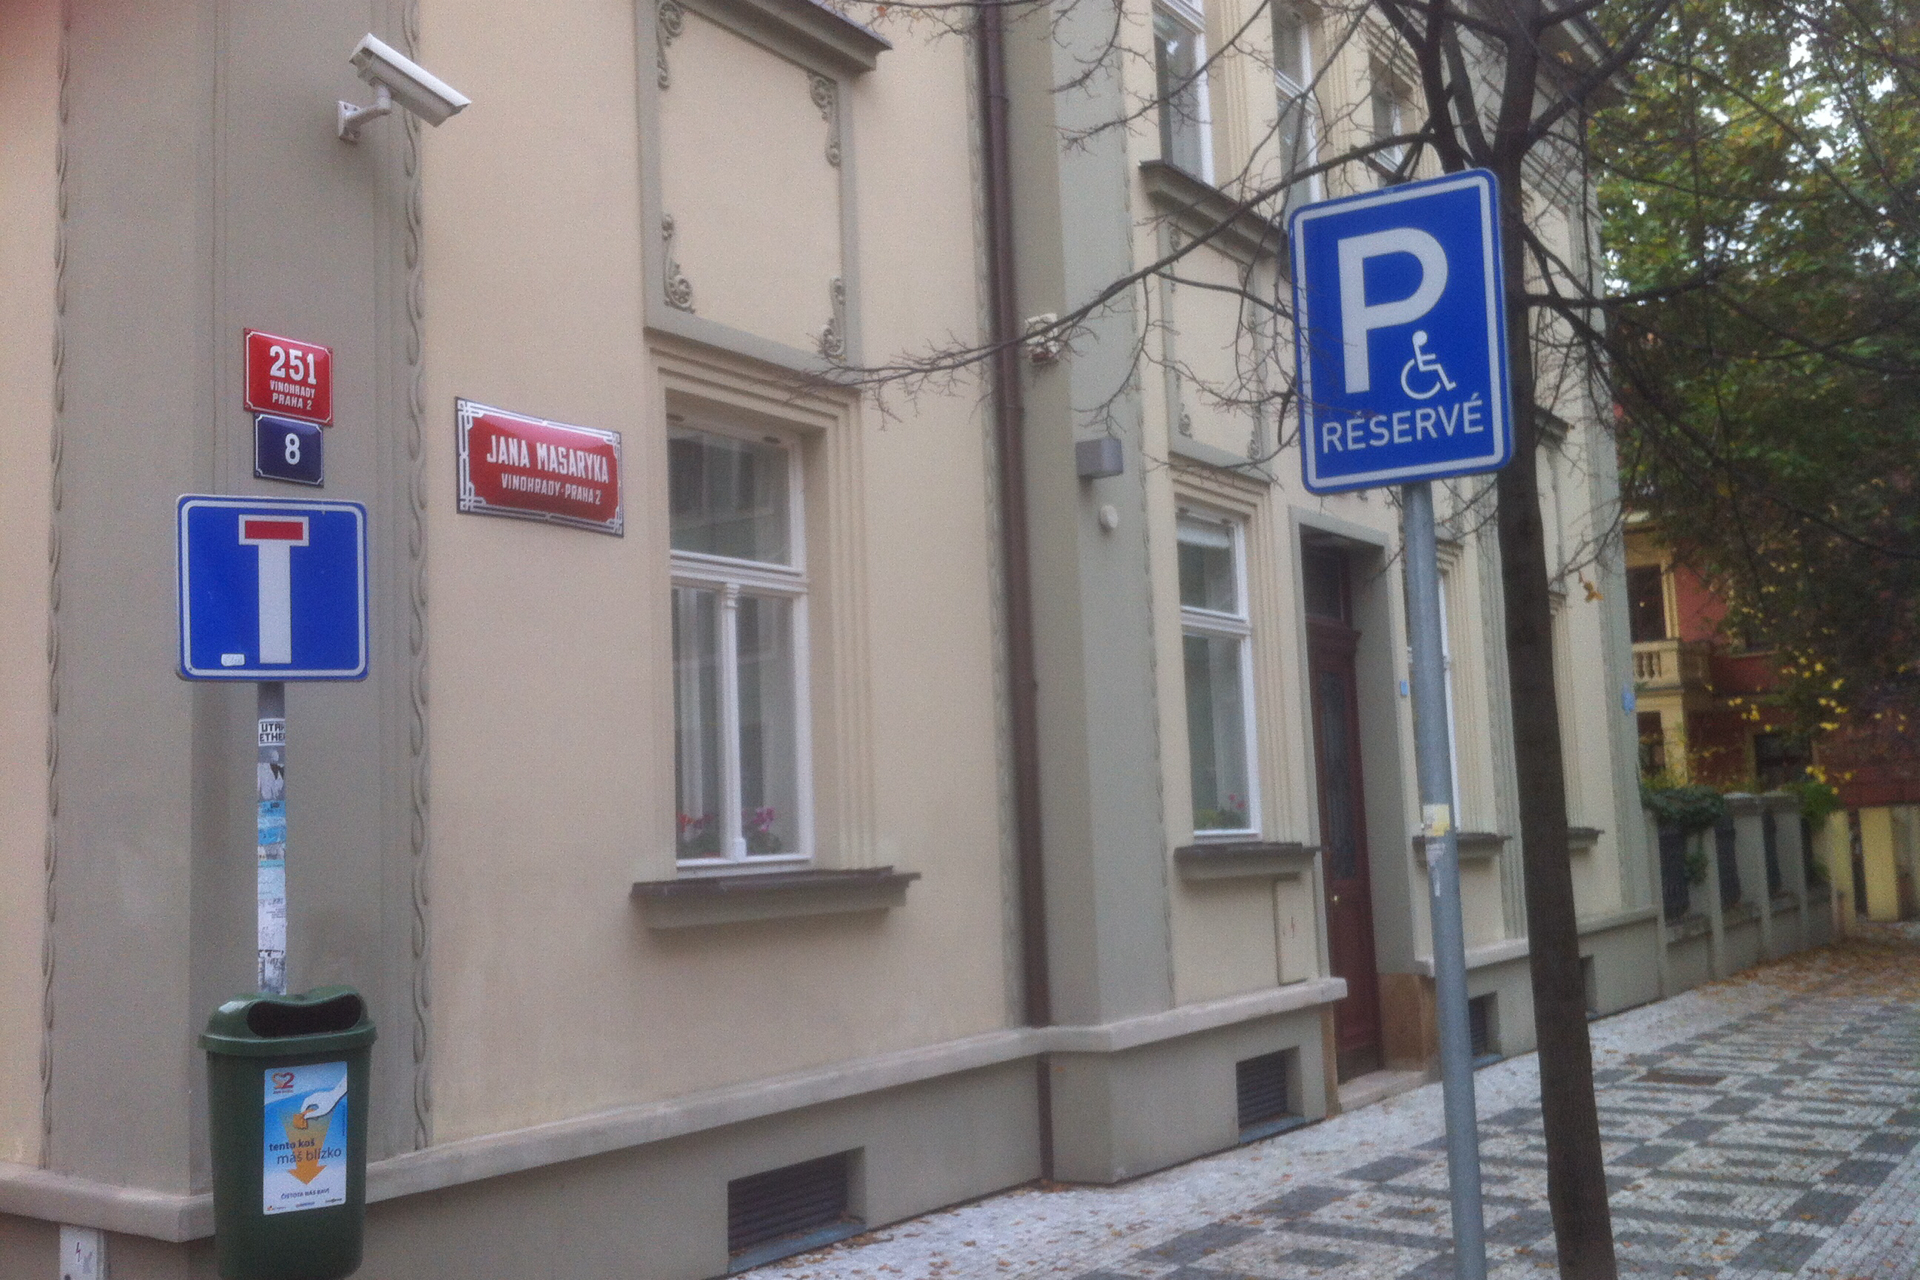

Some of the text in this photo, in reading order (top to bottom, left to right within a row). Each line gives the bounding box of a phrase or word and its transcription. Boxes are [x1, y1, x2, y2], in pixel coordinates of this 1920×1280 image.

[1337, 226, 1449, 394] P
[270, 345, 317, 385] 251
[271, 380, 315, 399] VINOHRADY
[272, 392, 313, 410] PRAHA 2
[1322, 392, 1484, 455] RÉSERVÉ
[285, 433, 300, 465] 8
[487, 435, 609, 484] JANA MASARYKA
[595, 489, 602, 505] 2
[268, 1138, 315, 1152] tento koš
[277, 1147, 342, 1165] máš blízko
